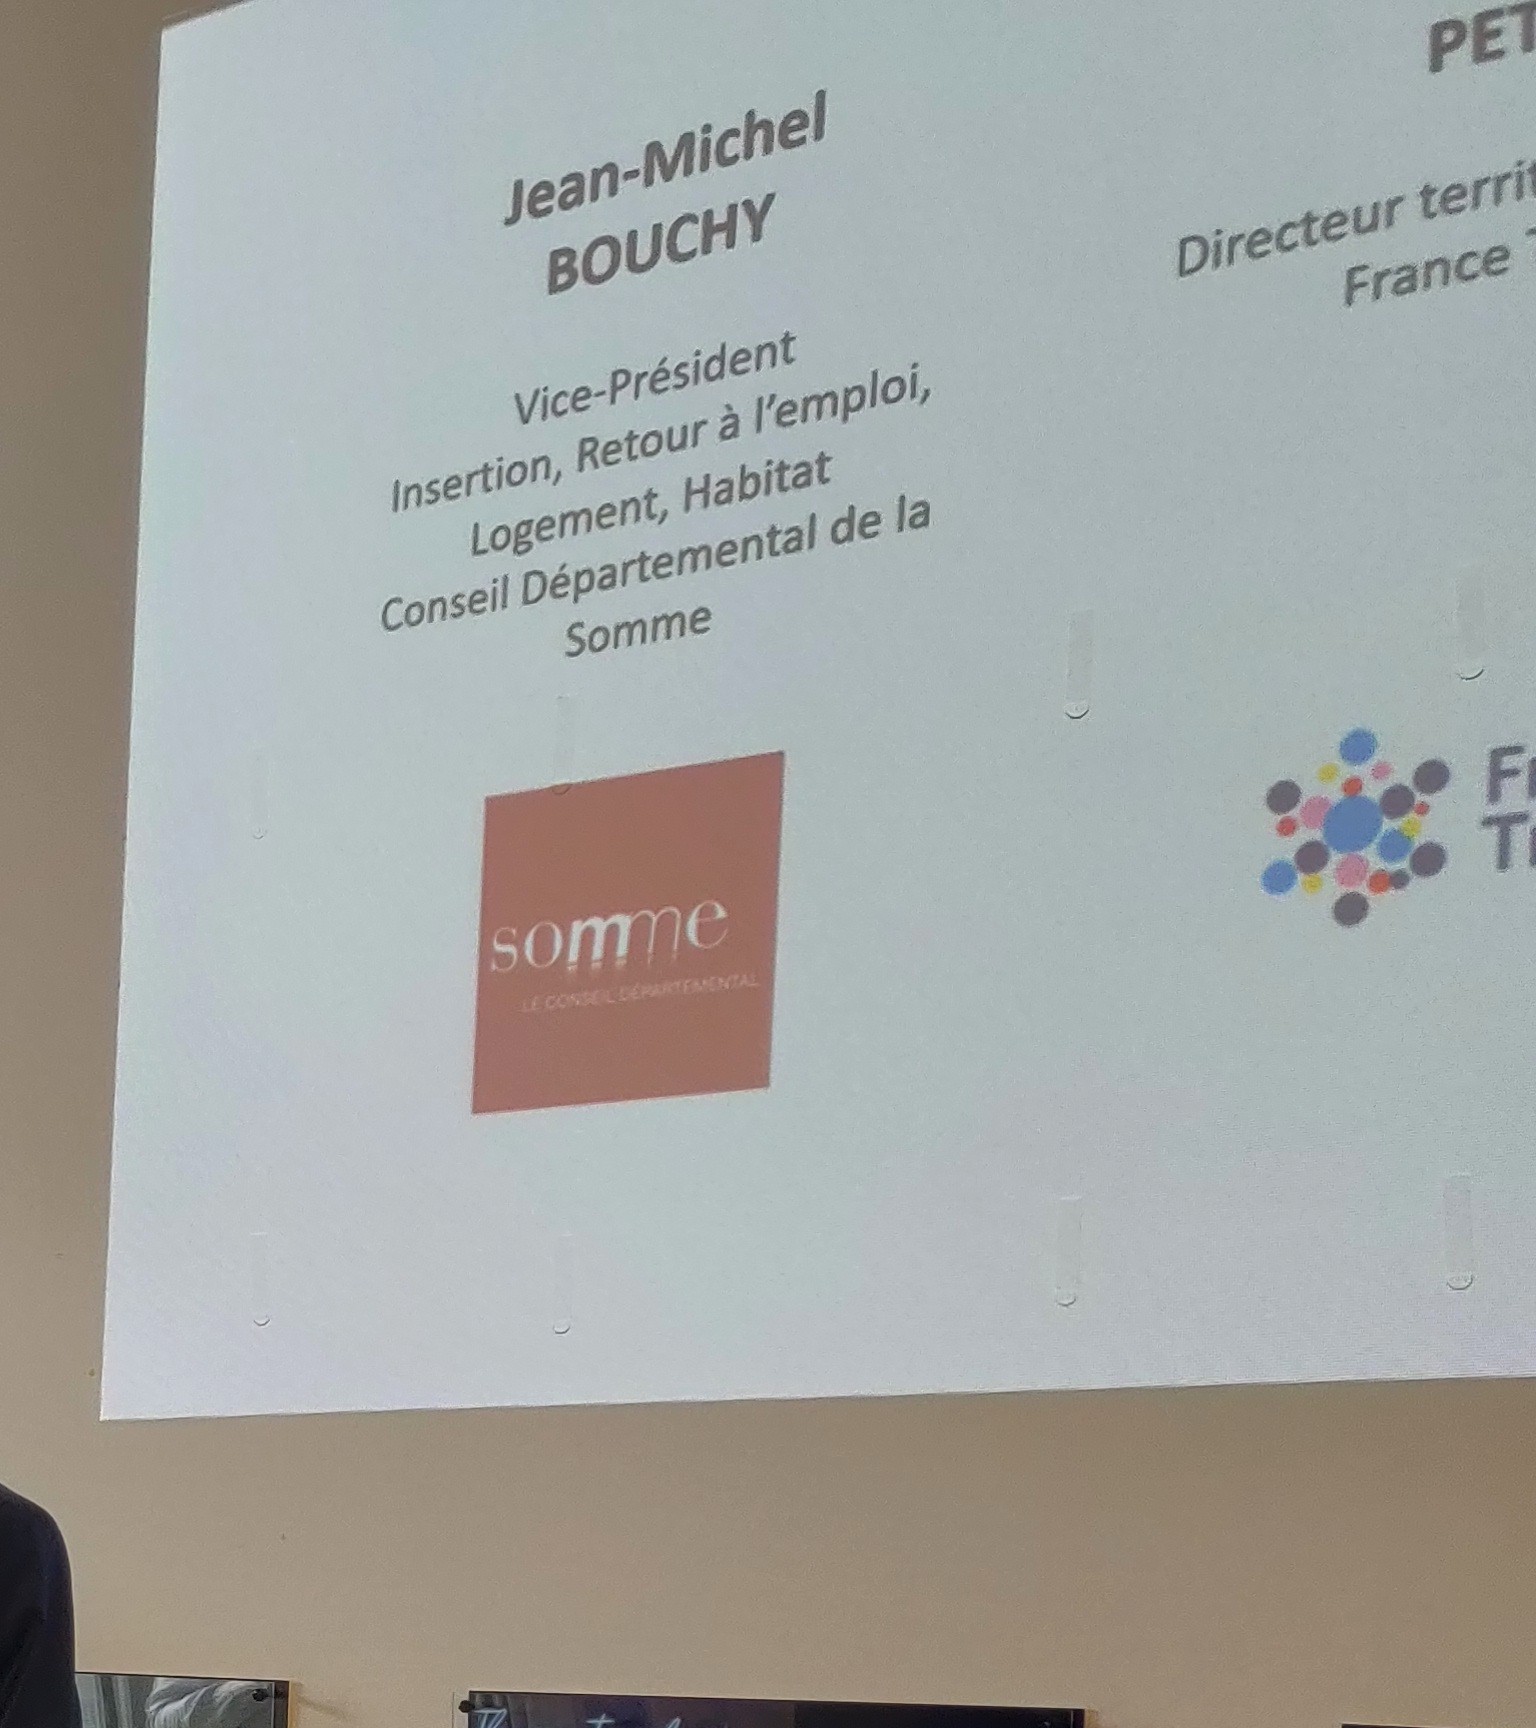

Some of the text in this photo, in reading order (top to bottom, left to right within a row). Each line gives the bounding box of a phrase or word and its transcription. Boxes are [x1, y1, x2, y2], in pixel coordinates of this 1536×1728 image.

[503, 88, 826, 226] Jean-Michel
[547, 191, 777, 295] BOUCHY
[1178, 194, 1406, 279] Directeur
[1343, 244, 1512, 308] France
[514, 329, 798, 427] Vice-Président
[391, 362, 932, 514] Insertion, Retour à l'emploi,
[470, 450, 834, 558] Logement, Habitat
[381, 493, 931, 633] Conseil Départemental de la
[565, 603, 713, 658] Somme
[490, 899, 728, 973] somme
